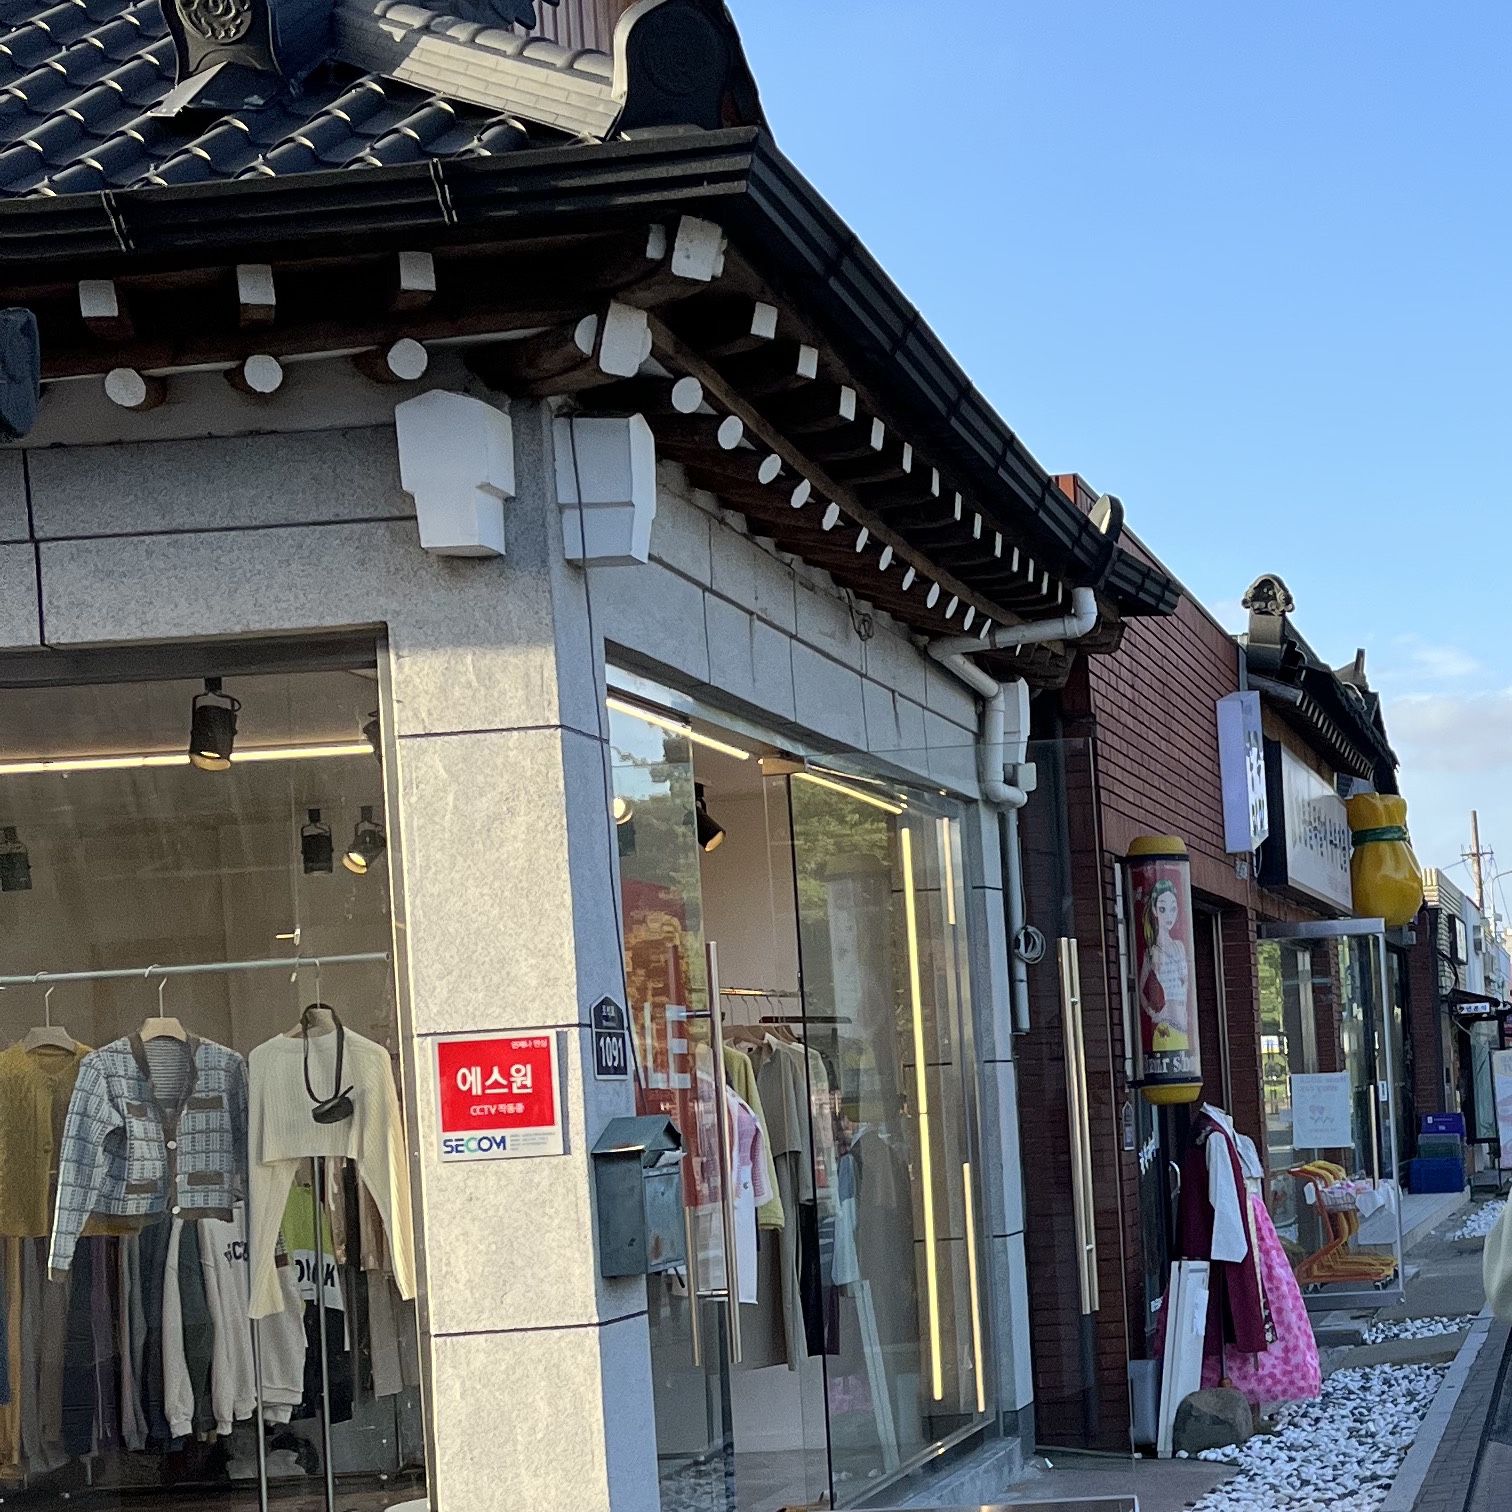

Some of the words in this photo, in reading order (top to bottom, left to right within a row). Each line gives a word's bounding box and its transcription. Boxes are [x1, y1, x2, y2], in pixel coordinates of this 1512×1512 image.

[599, 1036, 625, 1067] 1091
[456, 1063, 533, 1096] 에스원
[470, 1104, 497, 1116] CCTV
[498, 1103, 525, 1114] 작동중
[443, 1136, 506, 1154] SECOM
